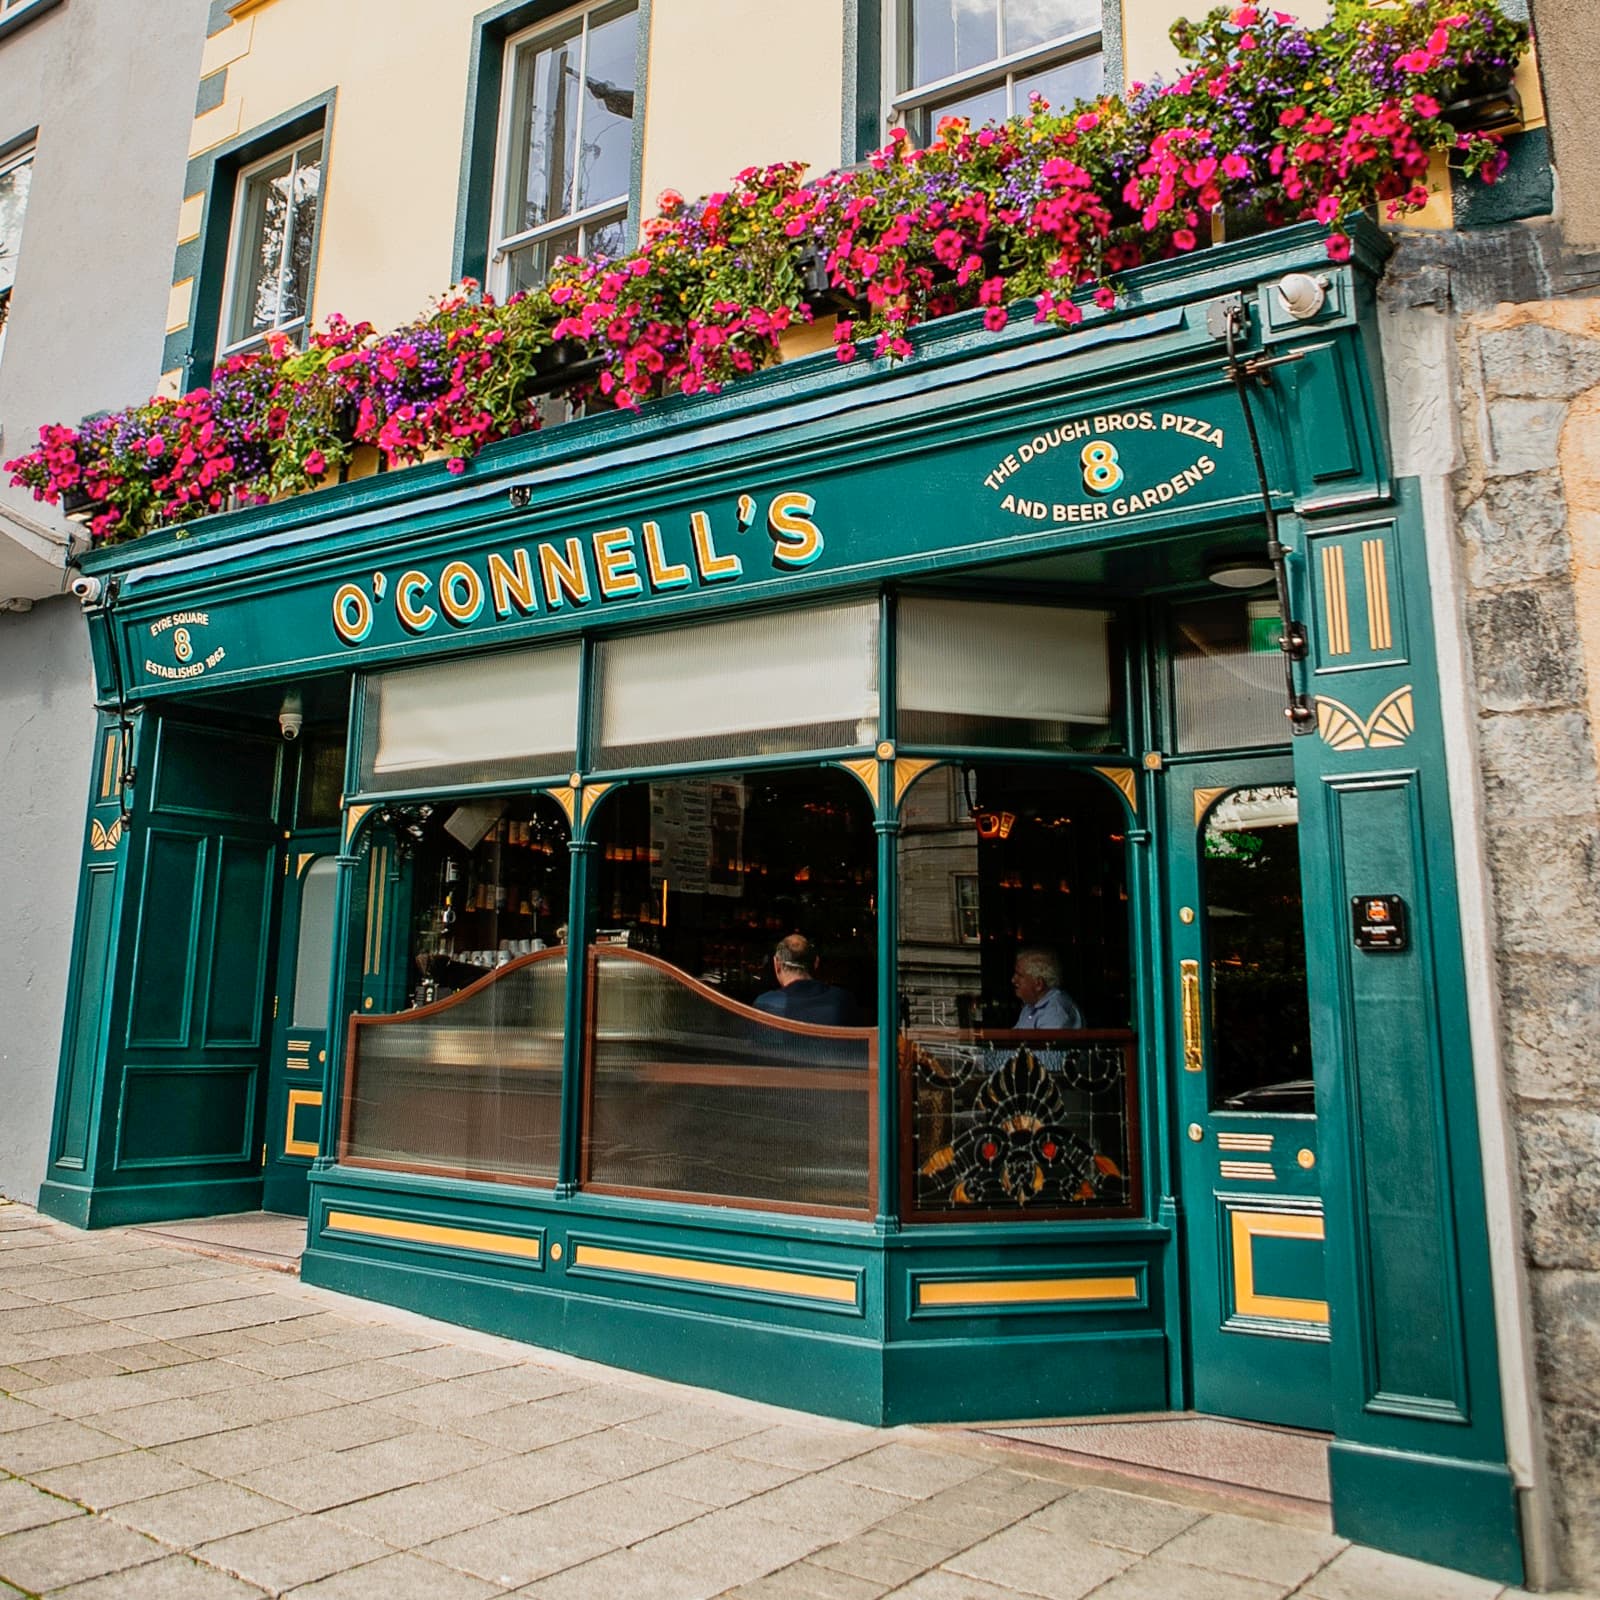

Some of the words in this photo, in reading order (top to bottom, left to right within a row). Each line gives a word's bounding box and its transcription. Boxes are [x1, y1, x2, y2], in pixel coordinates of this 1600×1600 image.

[983, 454, 1021, 491] THE
[1018, 419, 1091, 463] DOUGH
[1093, 412, 1157, 434] BROS.
[1161, 413, 1225, 449] PIZZA
[1080, 440, 1124, 496] 8
[1000, 494, 1048, 520] AND
[1052, 502, 1109, 522] BEER
[1112, 455, 1216, 516] GARDENS
[331, 490, 825, 644] O'CONNELL'S
[150, 616, 173, 637] EYRE
[173, 612, 209, 626] SQUARE
[174, 627, 193, 663] 8
[145, 659, 205, 679] ESTABLISHED
[205, 646, 226, 669] 1862
